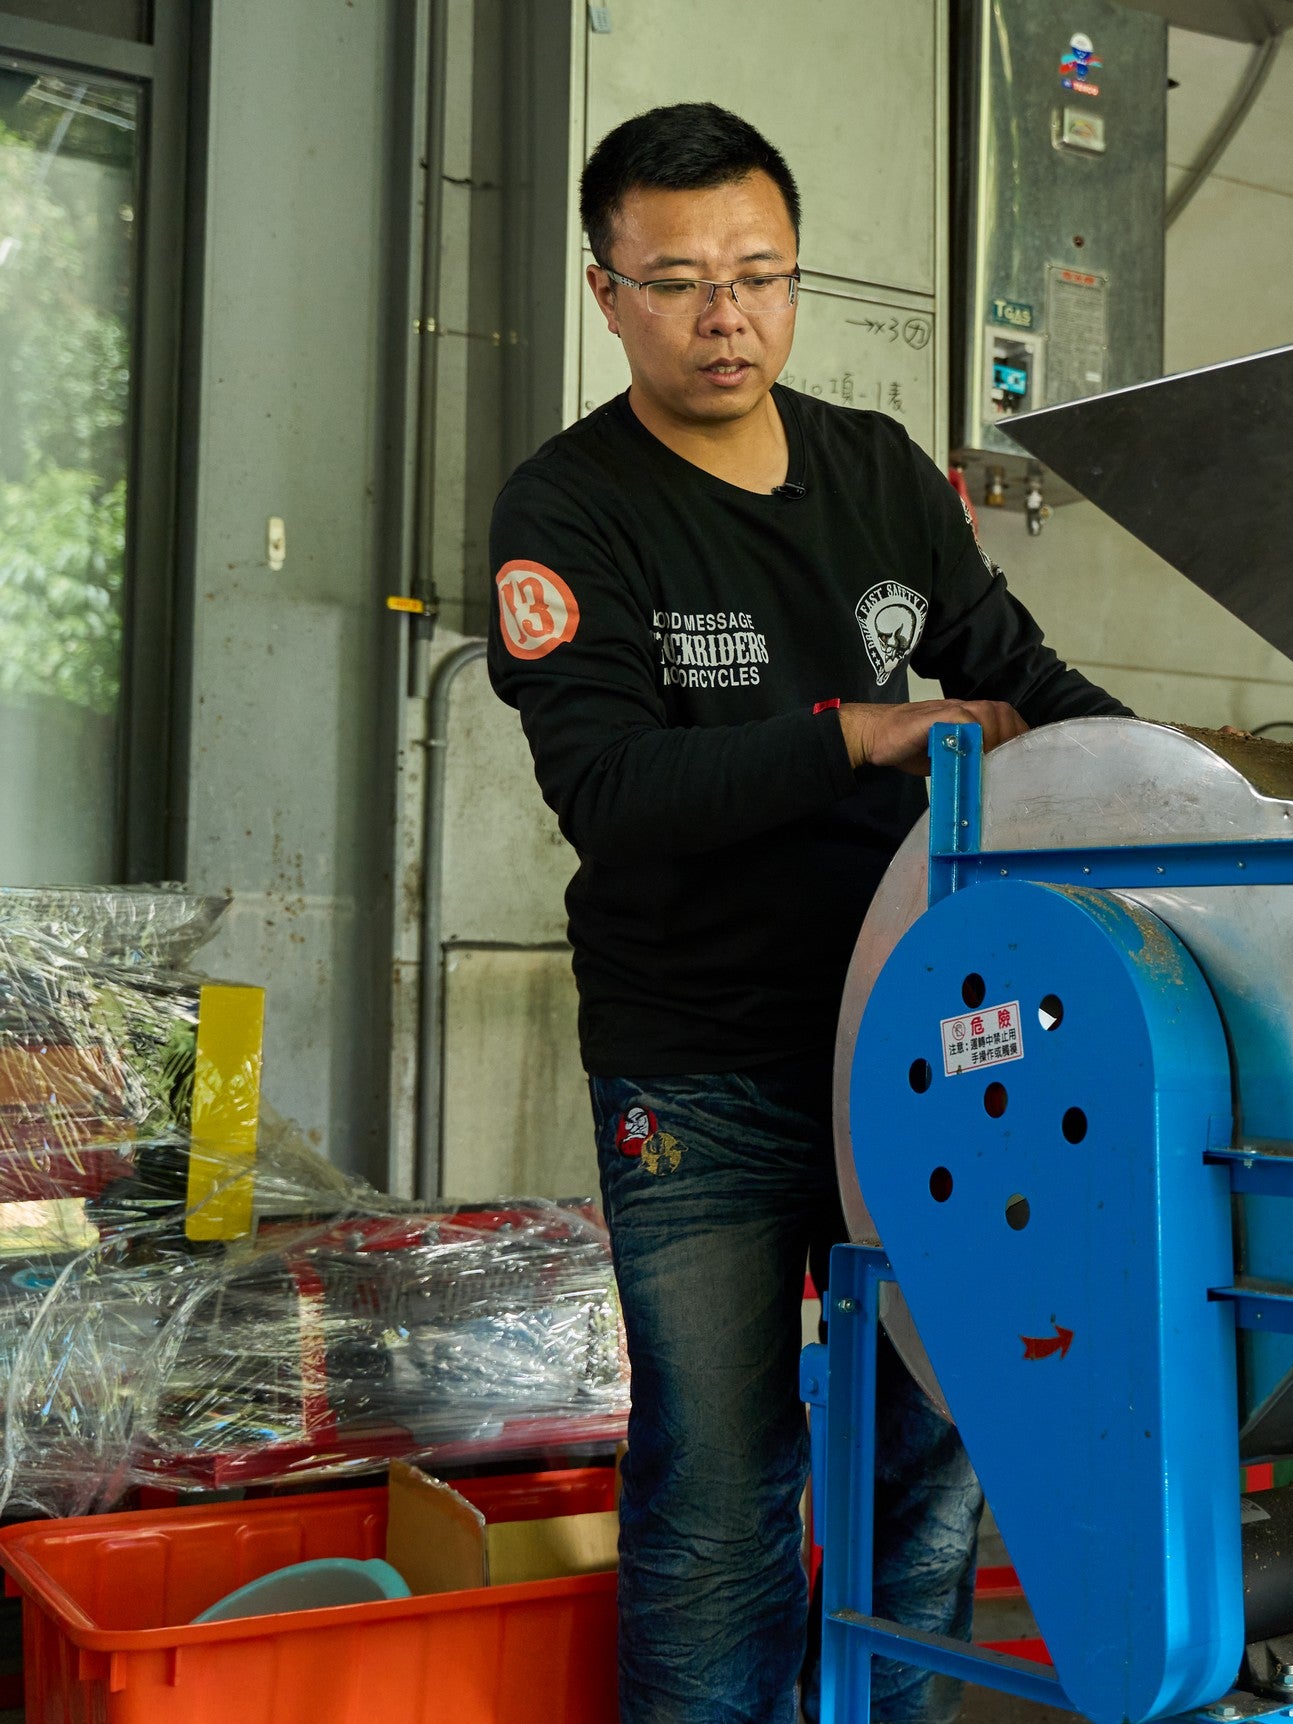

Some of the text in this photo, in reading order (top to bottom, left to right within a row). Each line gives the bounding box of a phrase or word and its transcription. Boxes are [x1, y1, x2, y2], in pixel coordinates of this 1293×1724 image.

[501, 577, 554, 645] 13
[860, 587, 883, 616] FAST
[886, 584, 920, 606] SAFETY
[683, 612, 755, 631] MESSAGE
